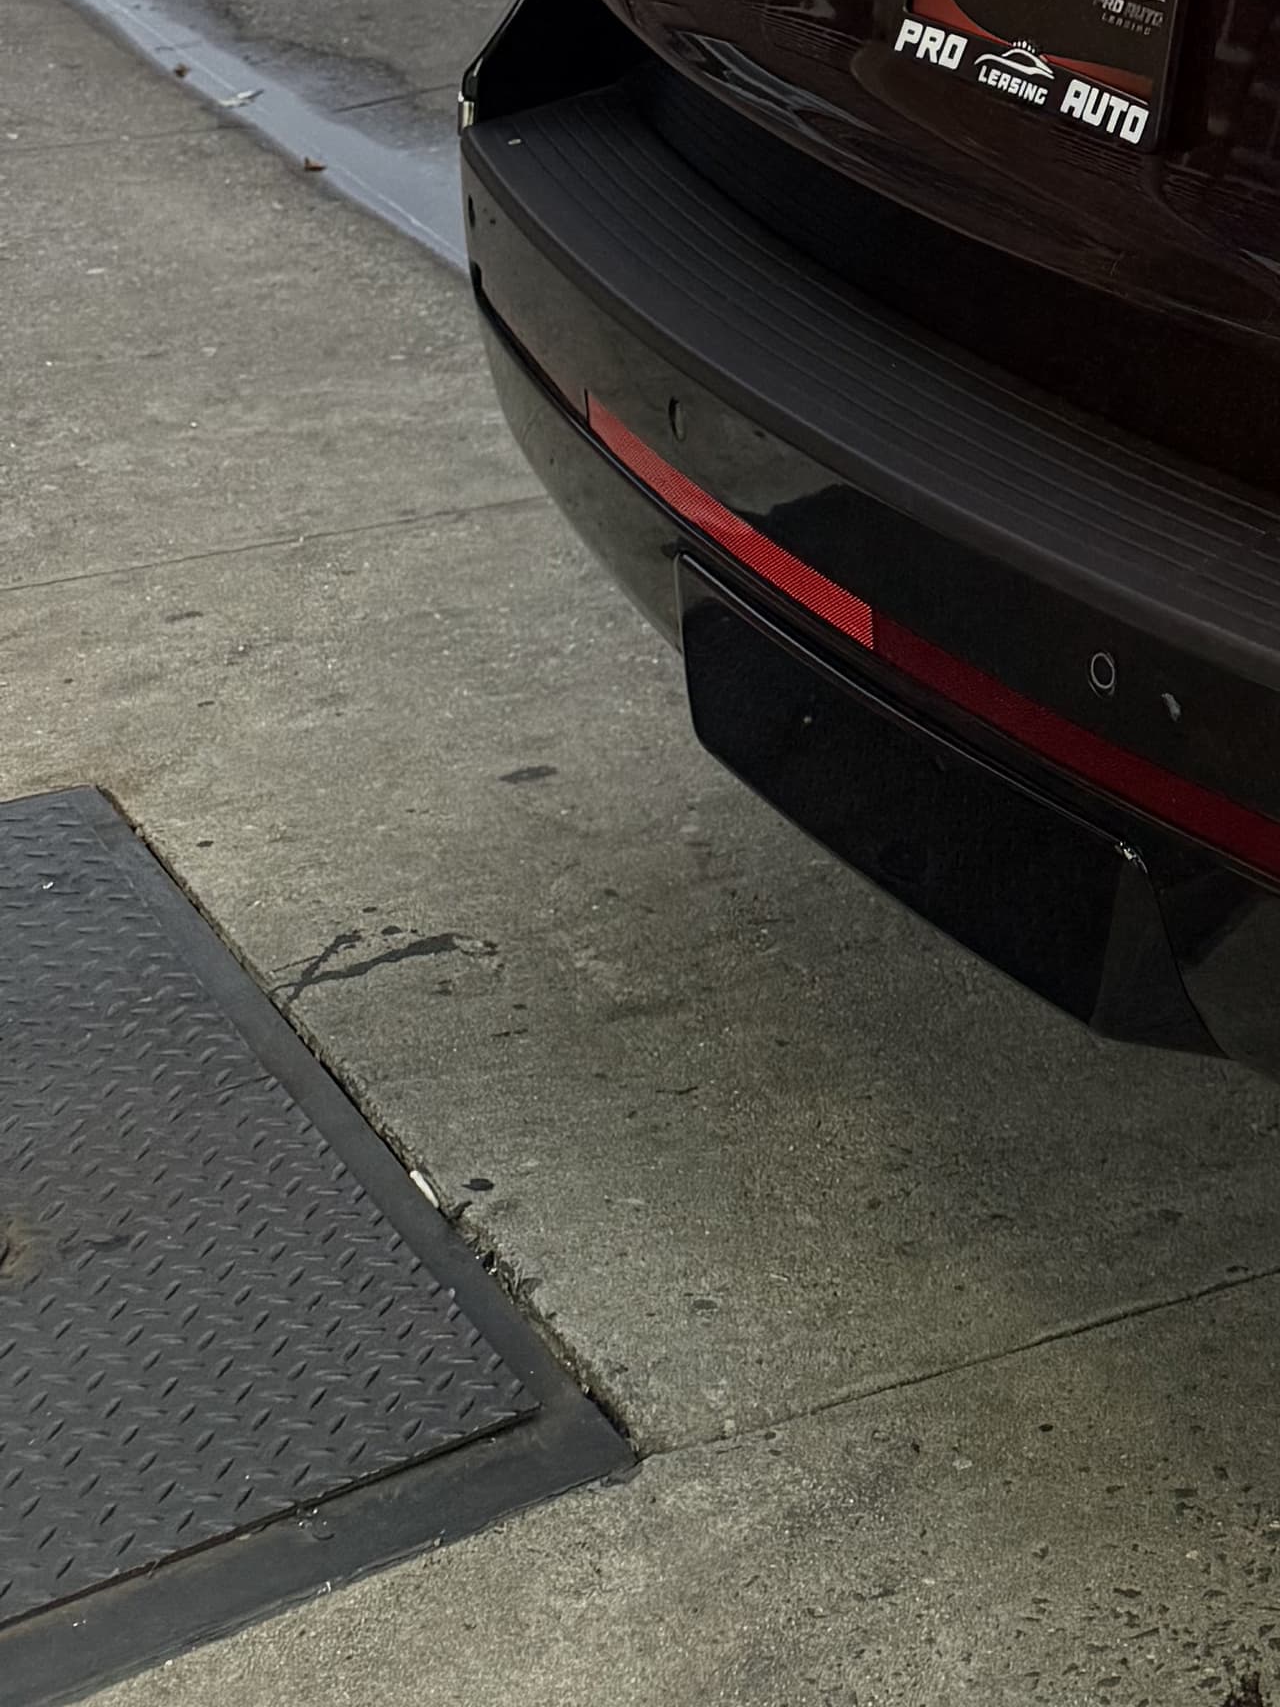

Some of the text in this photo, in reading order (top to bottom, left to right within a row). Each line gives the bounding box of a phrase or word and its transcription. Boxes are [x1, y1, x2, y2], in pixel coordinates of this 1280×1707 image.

[1101, 11, 1151, 36] LEASING
[1123, 1, 1164, 28] AUTO
[894, 18, 969, 70] PRO
[977, 65, 1049, 106] LEASING
[1060, 79, 1150, 145] AUTO
